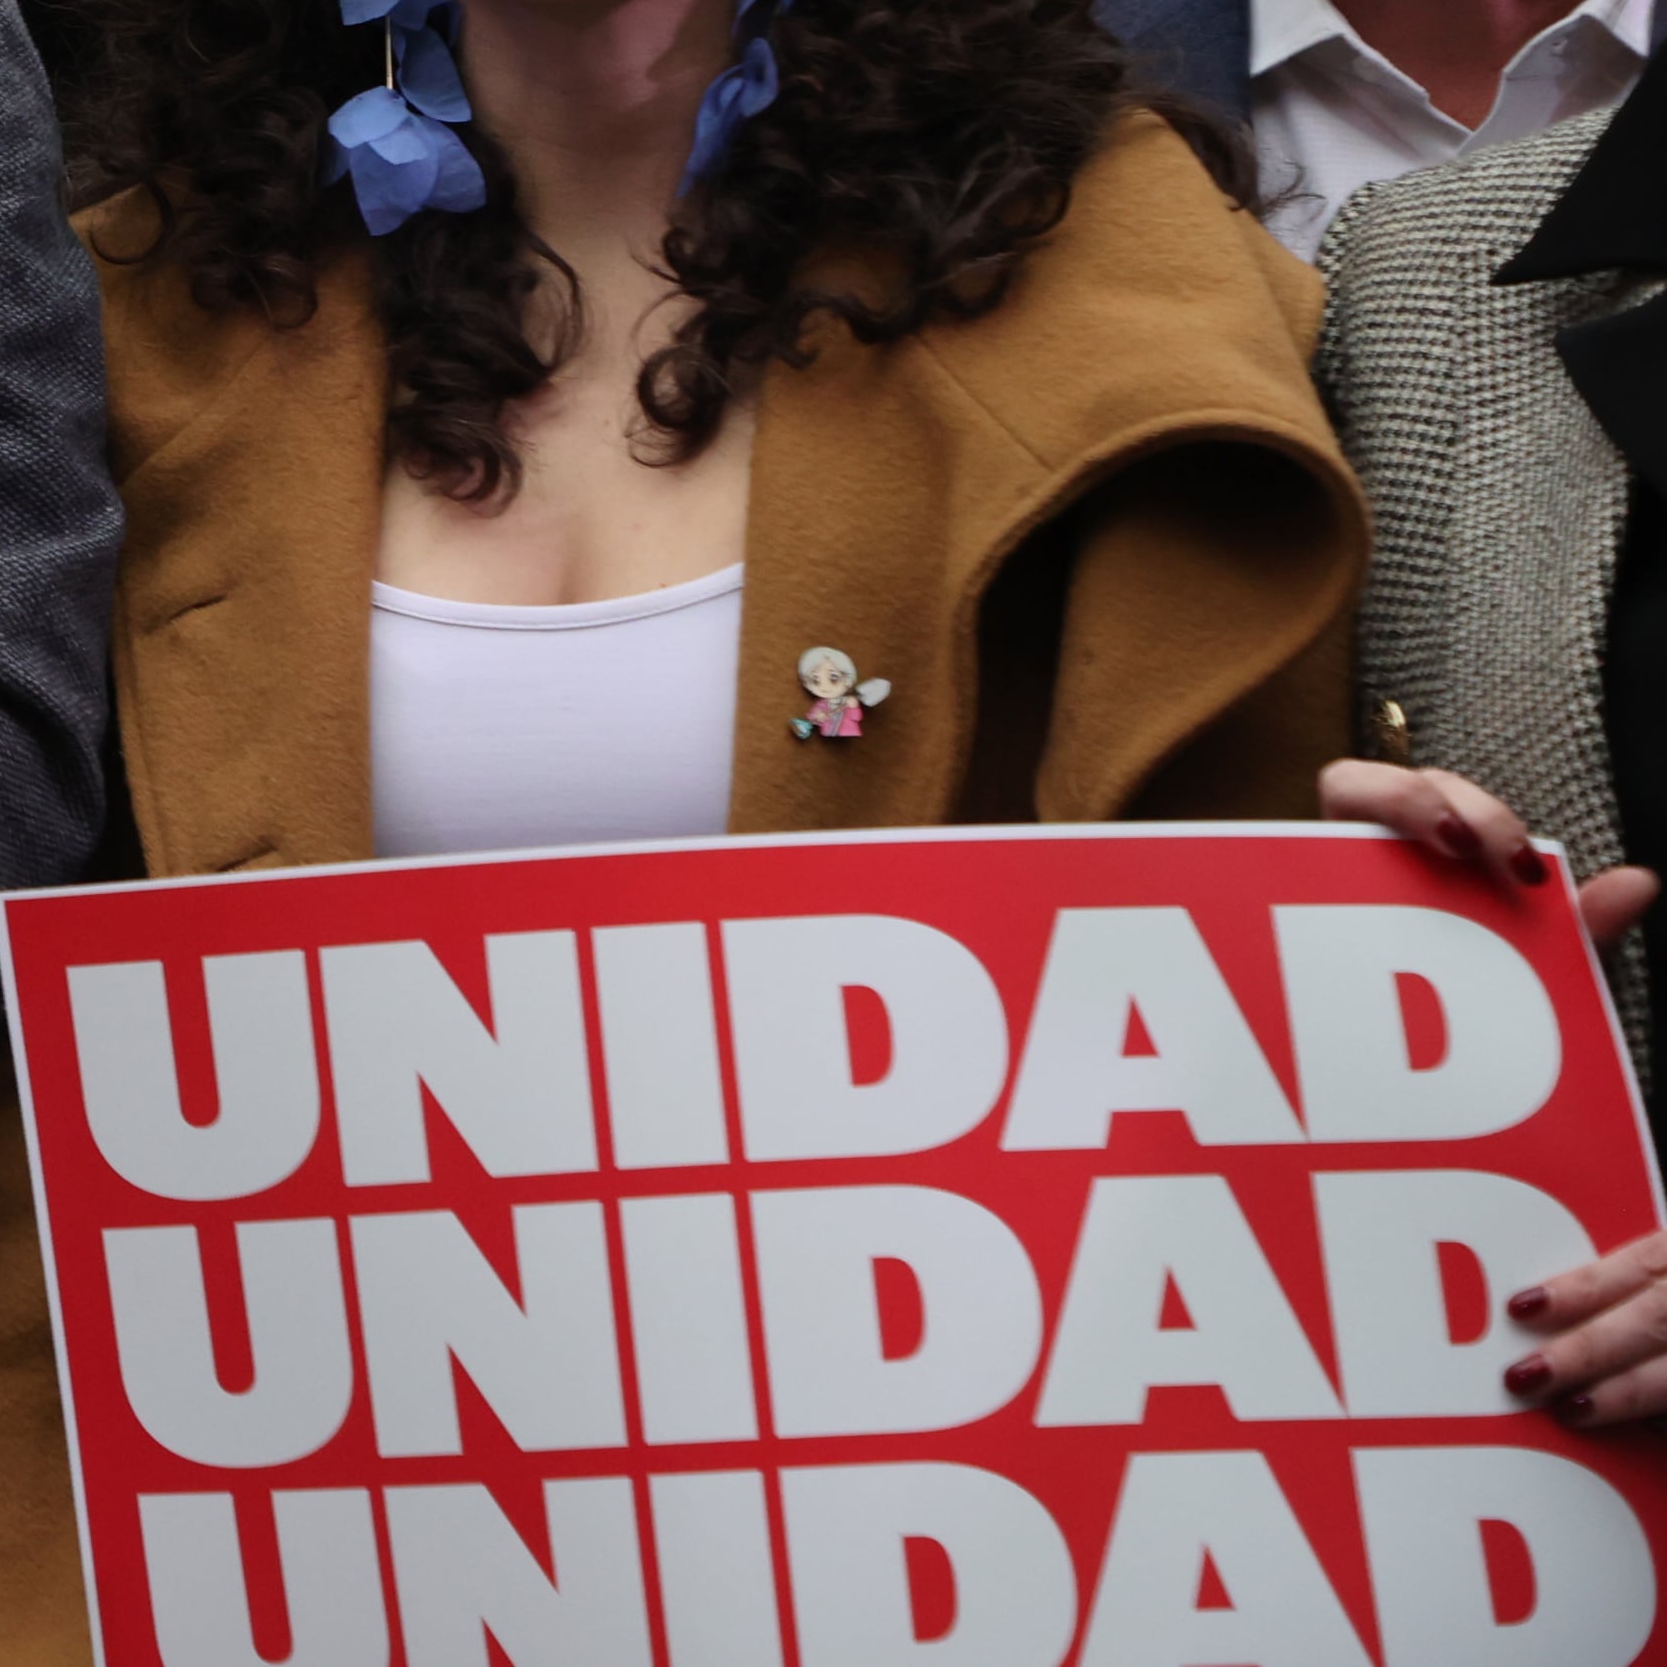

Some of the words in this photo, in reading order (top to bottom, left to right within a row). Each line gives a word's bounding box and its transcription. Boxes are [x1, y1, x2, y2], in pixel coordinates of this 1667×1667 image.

[66, 904, 1563, 1200] UNIDAD
[101, 1169, 1603, 1469] UNIDAD
[137, 1446, 1658, 1667] UNIDAD
